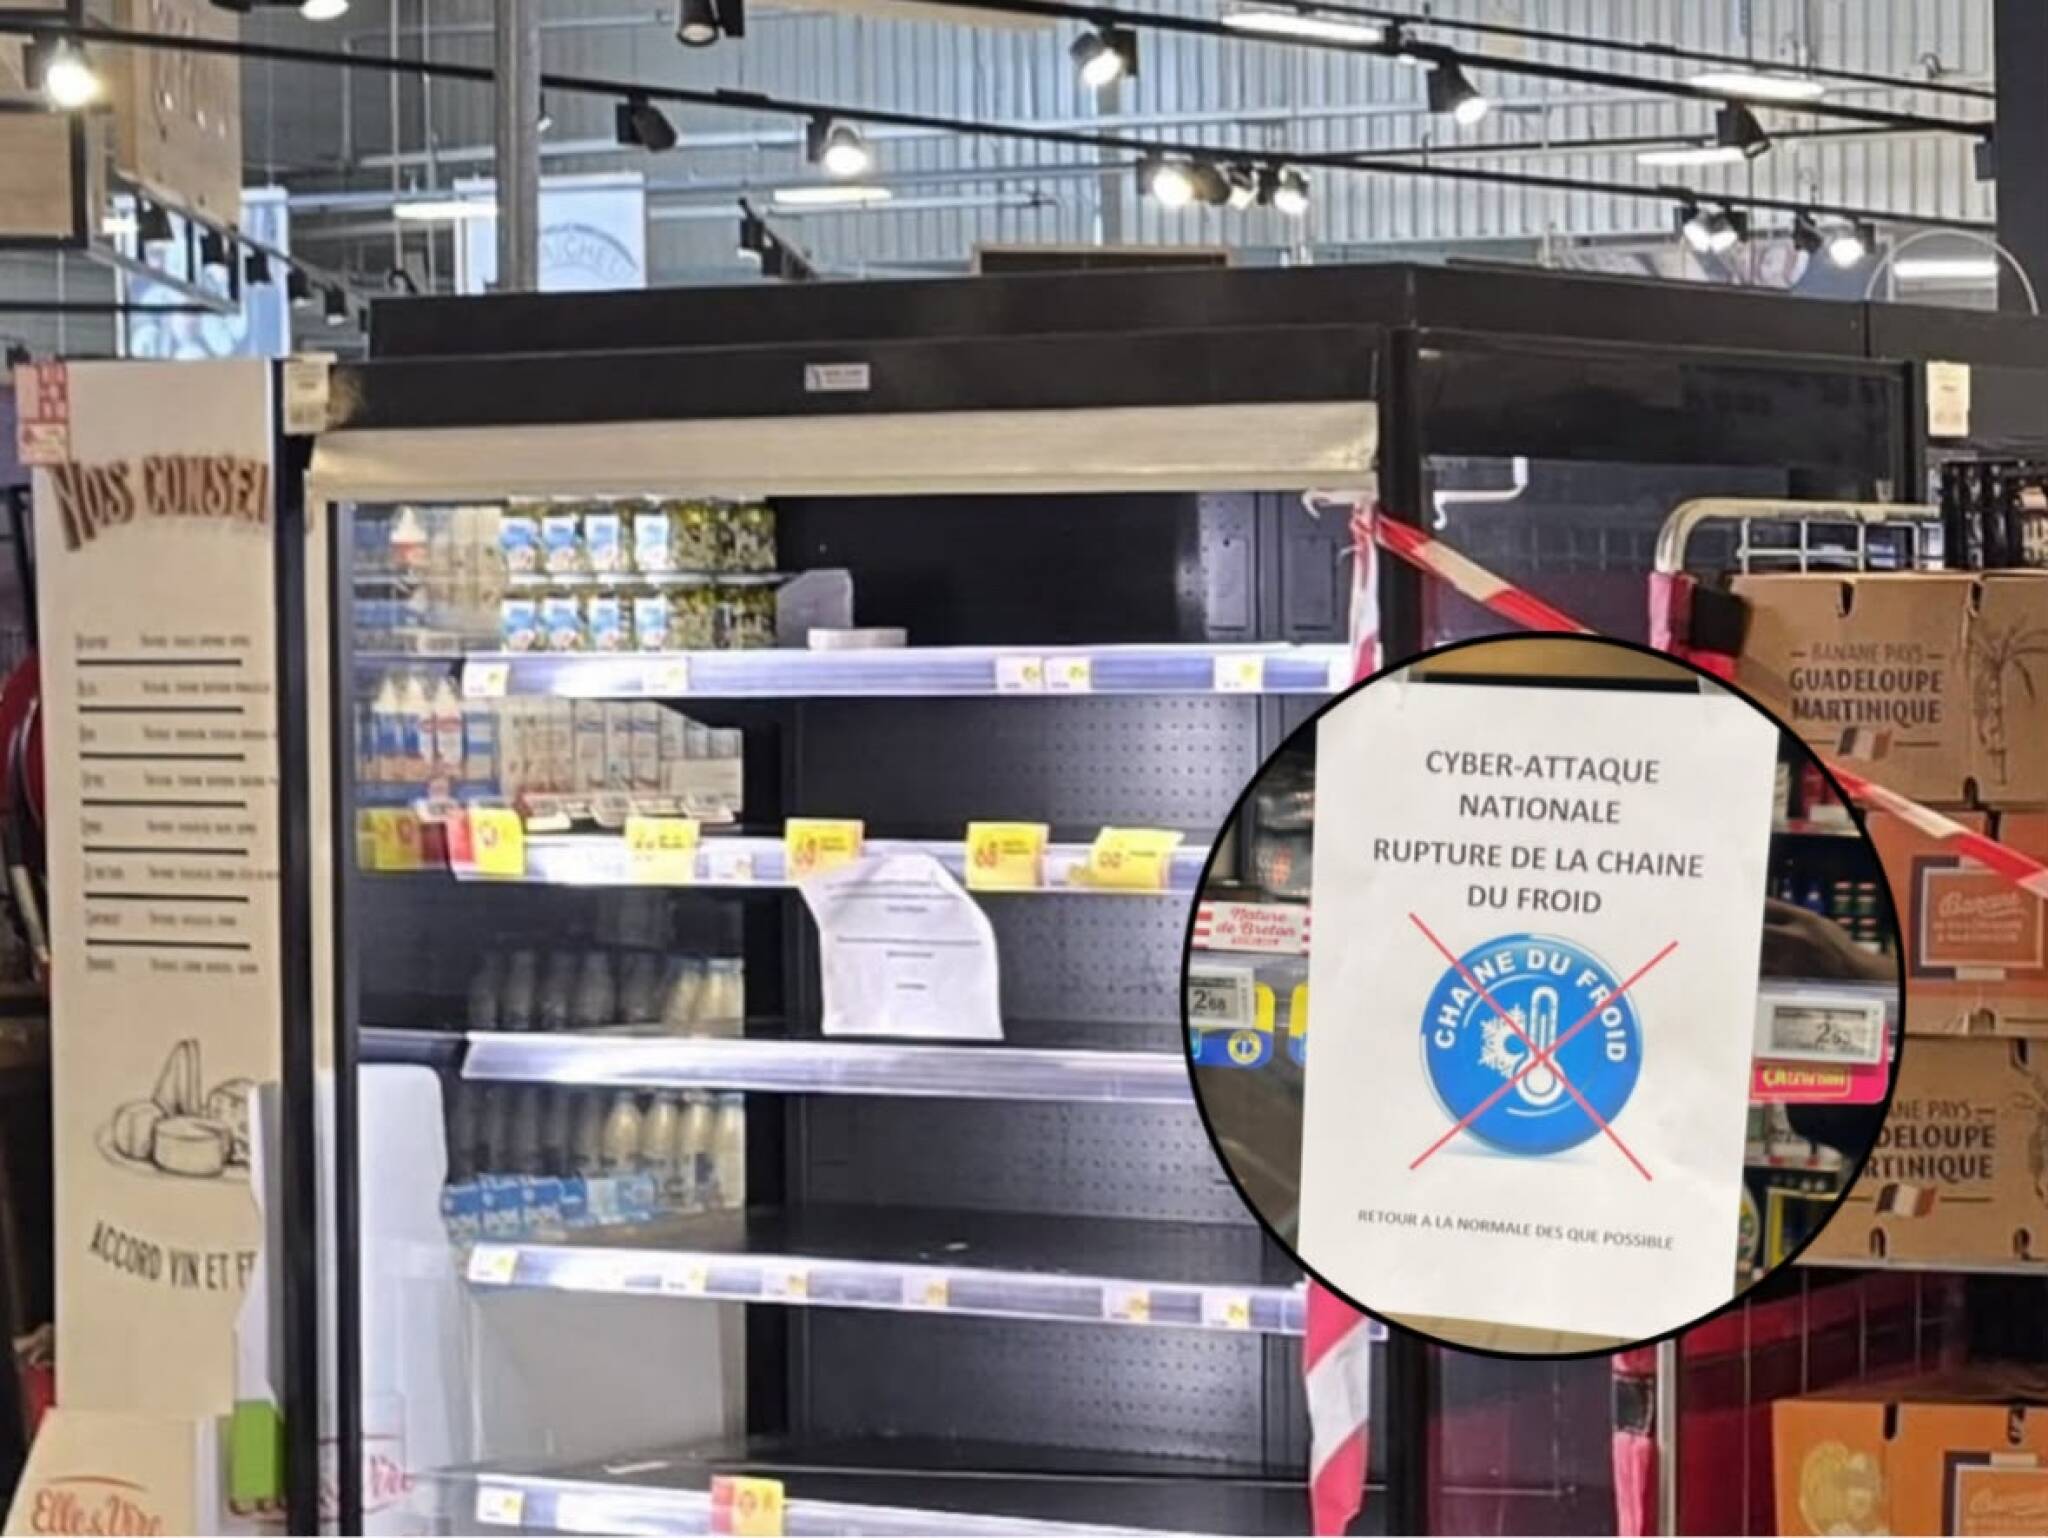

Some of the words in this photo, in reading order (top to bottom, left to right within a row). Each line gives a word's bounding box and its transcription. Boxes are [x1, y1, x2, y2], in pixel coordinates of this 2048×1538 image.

[52, 458, 135, 551] NOS
[1790, 667, 1943, 693] GUADELOUPE
[1792, 697, 1941, 728] MARTINIQUE
[1426, 750, 1660, 785] CYBER-ATTAQUE
[1459, 794, 1622, 824] NATIONALE
[1373, 838, 1501, 868] RUPTURE
[1511, 846, 1546, 870] DE
[1556, 848, 1588, 872] LA
[1597, 850, 1704, 878] CHAINE
[1467, 885, 1507, 909] DU
[1517, 888, 1602, 914] FROID
[1527, 949, 1571, 976] DU
[1575, 969, 1627, 1061] FROID
[1928, 1100, 1972, 1120] PAYS
[1358, 1208, 1417, 1227] RETOUR
[1421, 1214, 1432, 1228] A
[1436, 1215, 1453, 1230] LA
[1456, 1217, 1531, 1237] NORMALE
[1535, 1224, 1563, 1239] DES
[1567, 1227, 1598, 1244] QUE
[1602, 1231, 1673, 1250] POSSIBLE
[90, 1221, 162, 1280] ACCORD
[170, 1250, 199, 1288] VIN
[206, 1253, 229, 1290] ET
